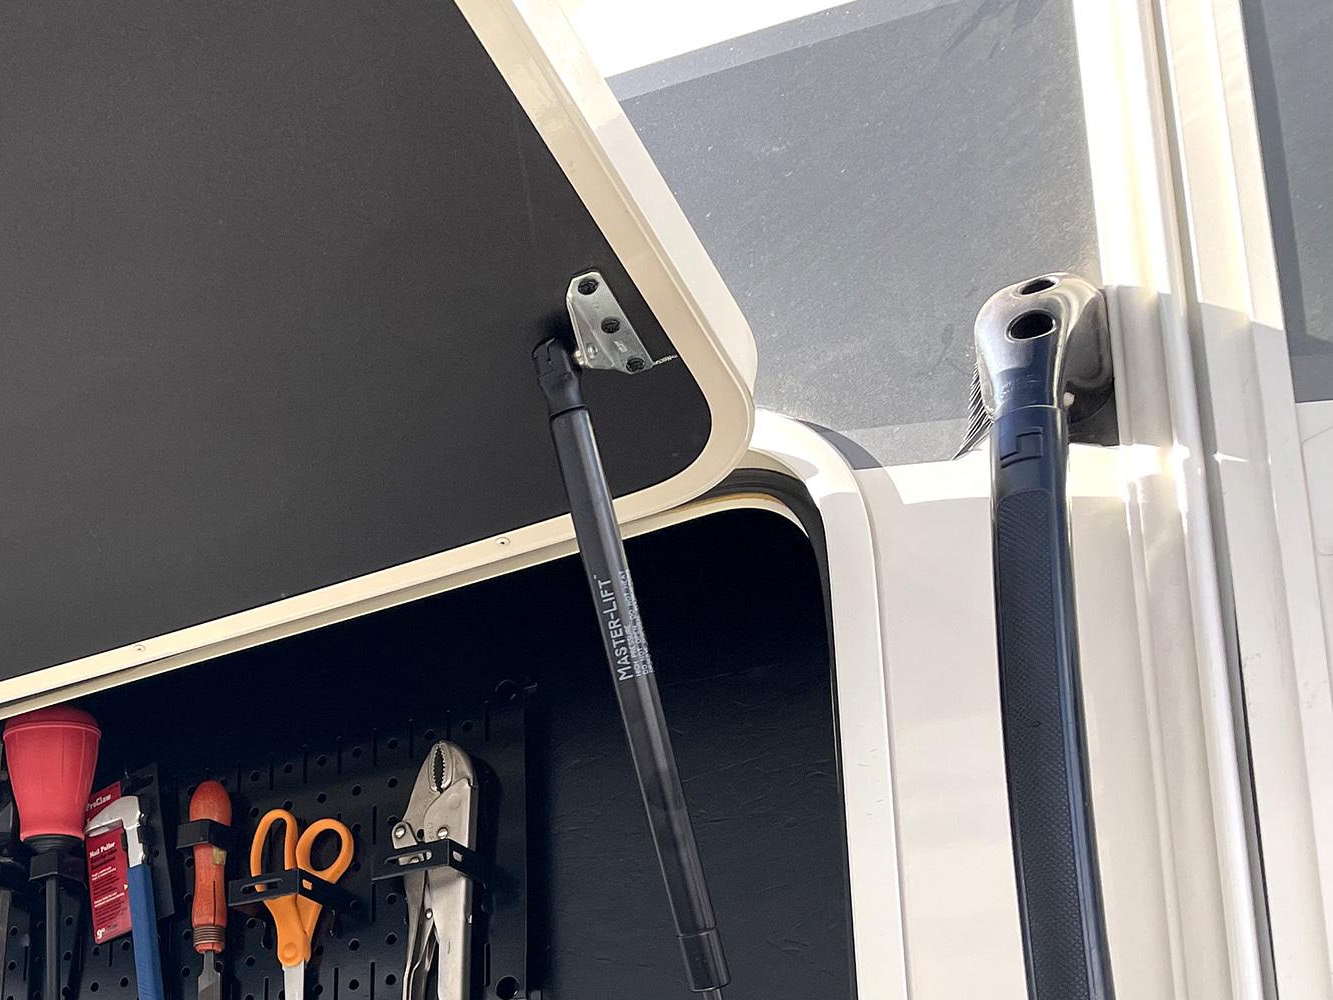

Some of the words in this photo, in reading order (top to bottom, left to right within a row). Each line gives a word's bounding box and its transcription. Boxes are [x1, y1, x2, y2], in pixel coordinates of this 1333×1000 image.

[597, 579, 634, 681] MASTER-LIFT
[89, 848, 100, 859] Nail
[100, 841, 116, 853] Puller
